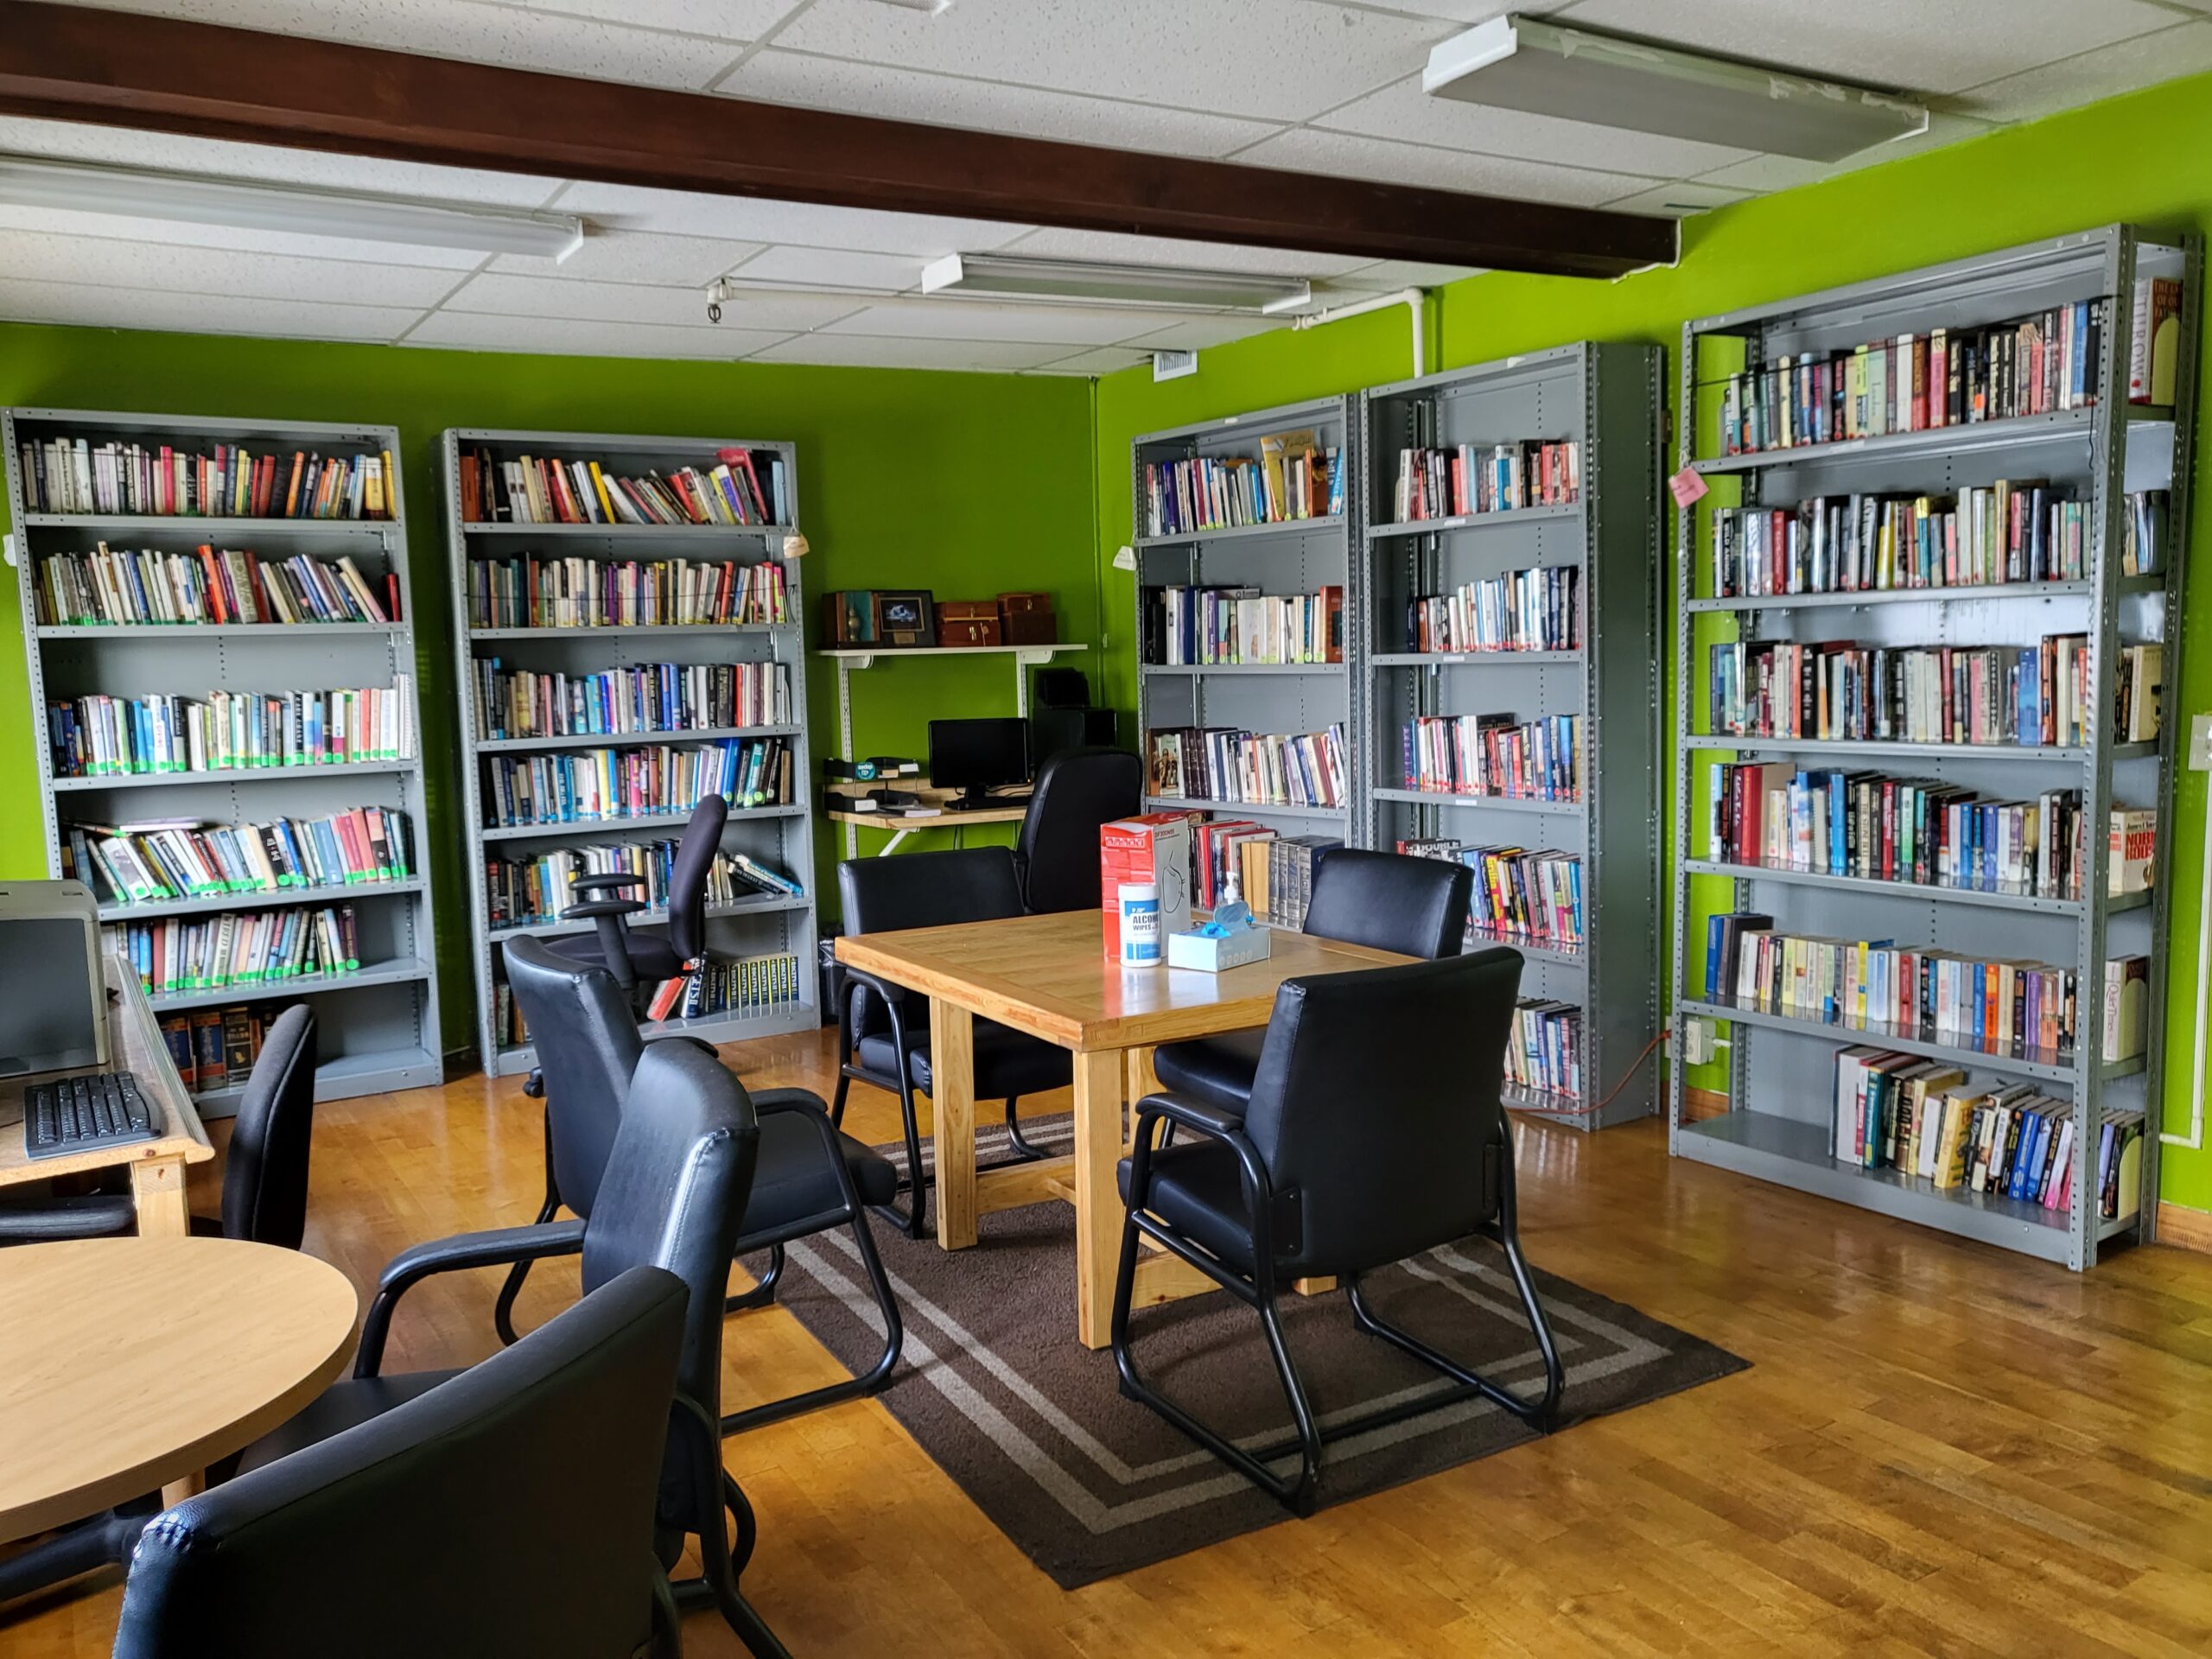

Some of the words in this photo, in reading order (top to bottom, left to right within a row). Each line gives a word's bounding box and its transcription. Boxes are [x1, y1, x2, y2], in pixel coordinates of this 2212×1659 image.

[2126, 830, 2156, 848] NOBL
[2125, 845, 2155, 861] HOUS
[1133, 913, 1158, 924] ALCOH
